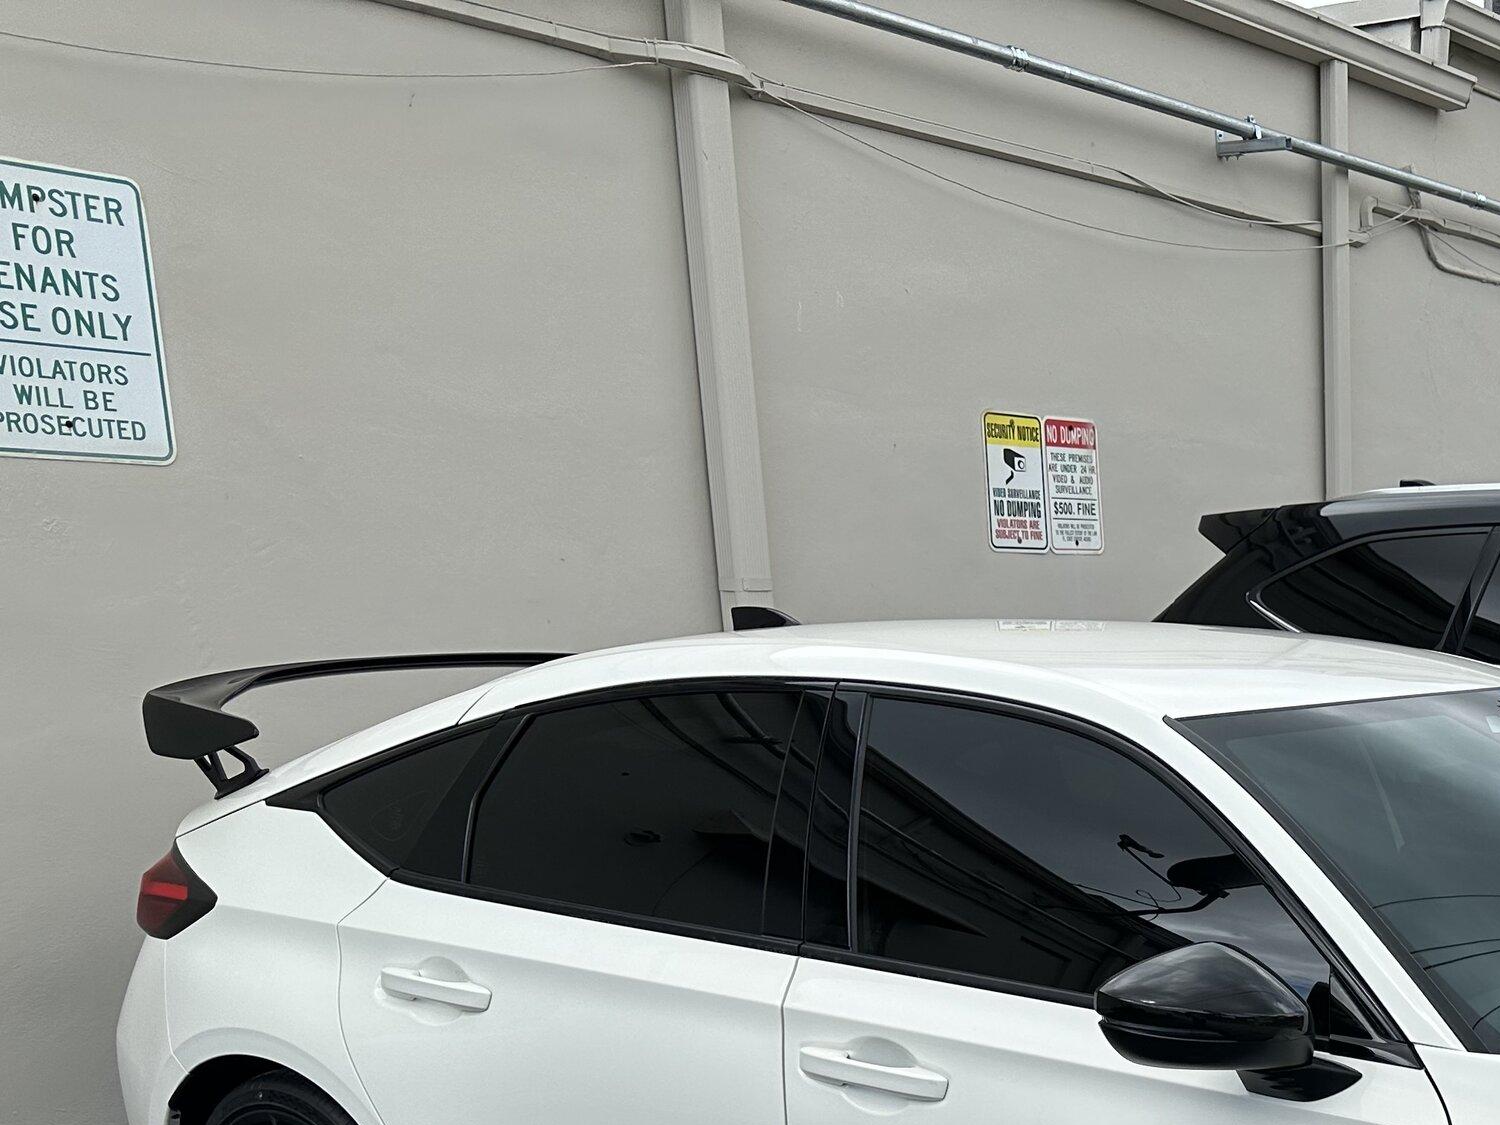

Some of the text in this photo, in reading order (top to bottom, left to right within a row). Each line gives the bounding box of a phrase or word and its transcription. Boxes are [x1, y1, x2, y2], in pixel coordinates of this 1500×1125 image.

[0, 180, 125, 226] MPSTER
[12, 222, 77, 258] FOR
[0, 260, 120, 302] ENANTS
[0, 300, 132, 342] SE ONLY
[13, 384, 118, 412] WILL BE
[987, 422, 1039, 442] SECURITY NOTICE
[1046, 424, 1094, 446] NO DUMPING
[1060, 464, 1077, 473] UNDER
[1052, 474, 1068, 484] VIDEO
[1079, 476, 1094, 485] AUDIO
[1055, 485, 1092, 495] SURVEILLANCE
[994, 499, 1041, 518] NO DUMPING
[1077, 502, 1097, 516] FINE
[997, 518, 1040, 530] VIOLATORS ARE
[1021, 530, 1029, 540] TO
